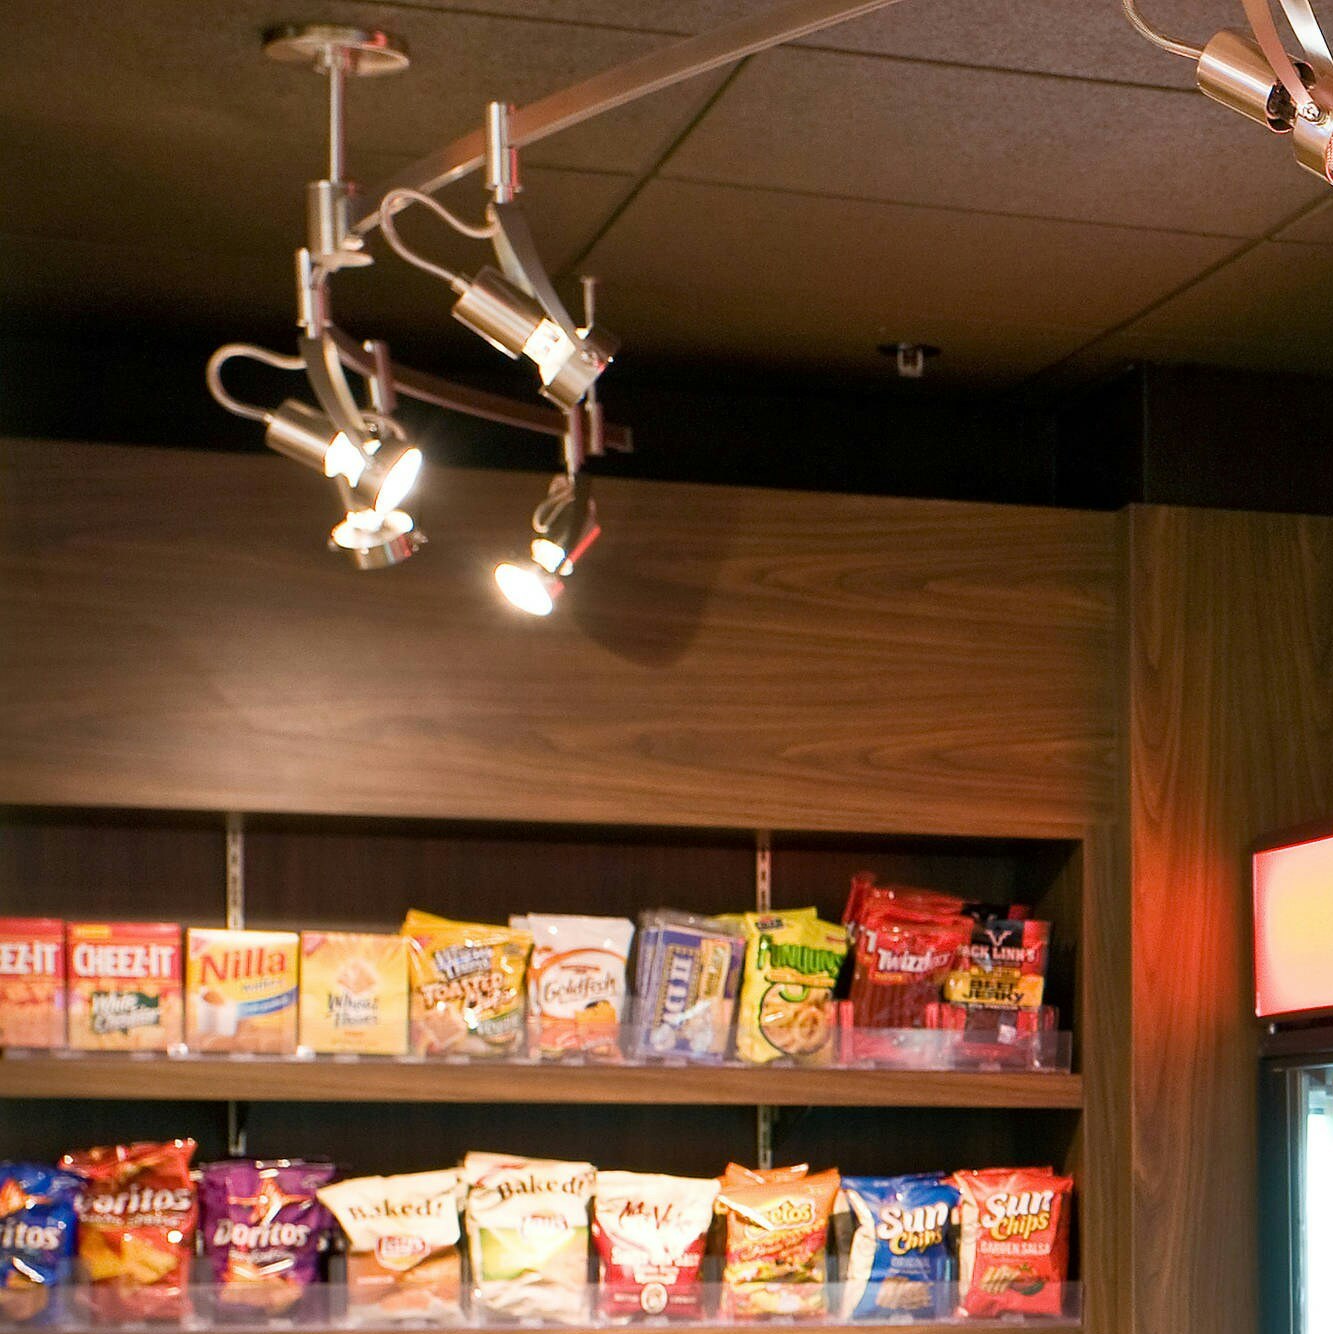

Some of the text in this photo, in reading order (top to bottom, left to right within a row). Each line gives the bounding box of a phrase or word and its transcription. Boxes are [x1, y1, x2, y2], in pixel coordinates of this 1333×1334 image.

[73, 944, 176, 977] CHEEZ-IT
[200, 946, 288, 985] Nilla
[958, 944, 989, 960] ACK
[73, 1185, 193, 1217] Doritos
[497, 1174, 585, 1201] Baked!
[877, 1201, 949, 1240] Sun
[981, 1189, 1054, 1228] Sun
[213, 1219, 313, 1249] Doritos
[888, 1228, 943, 1256] Chips
[989, 1212, 1050, 1241] Chips
